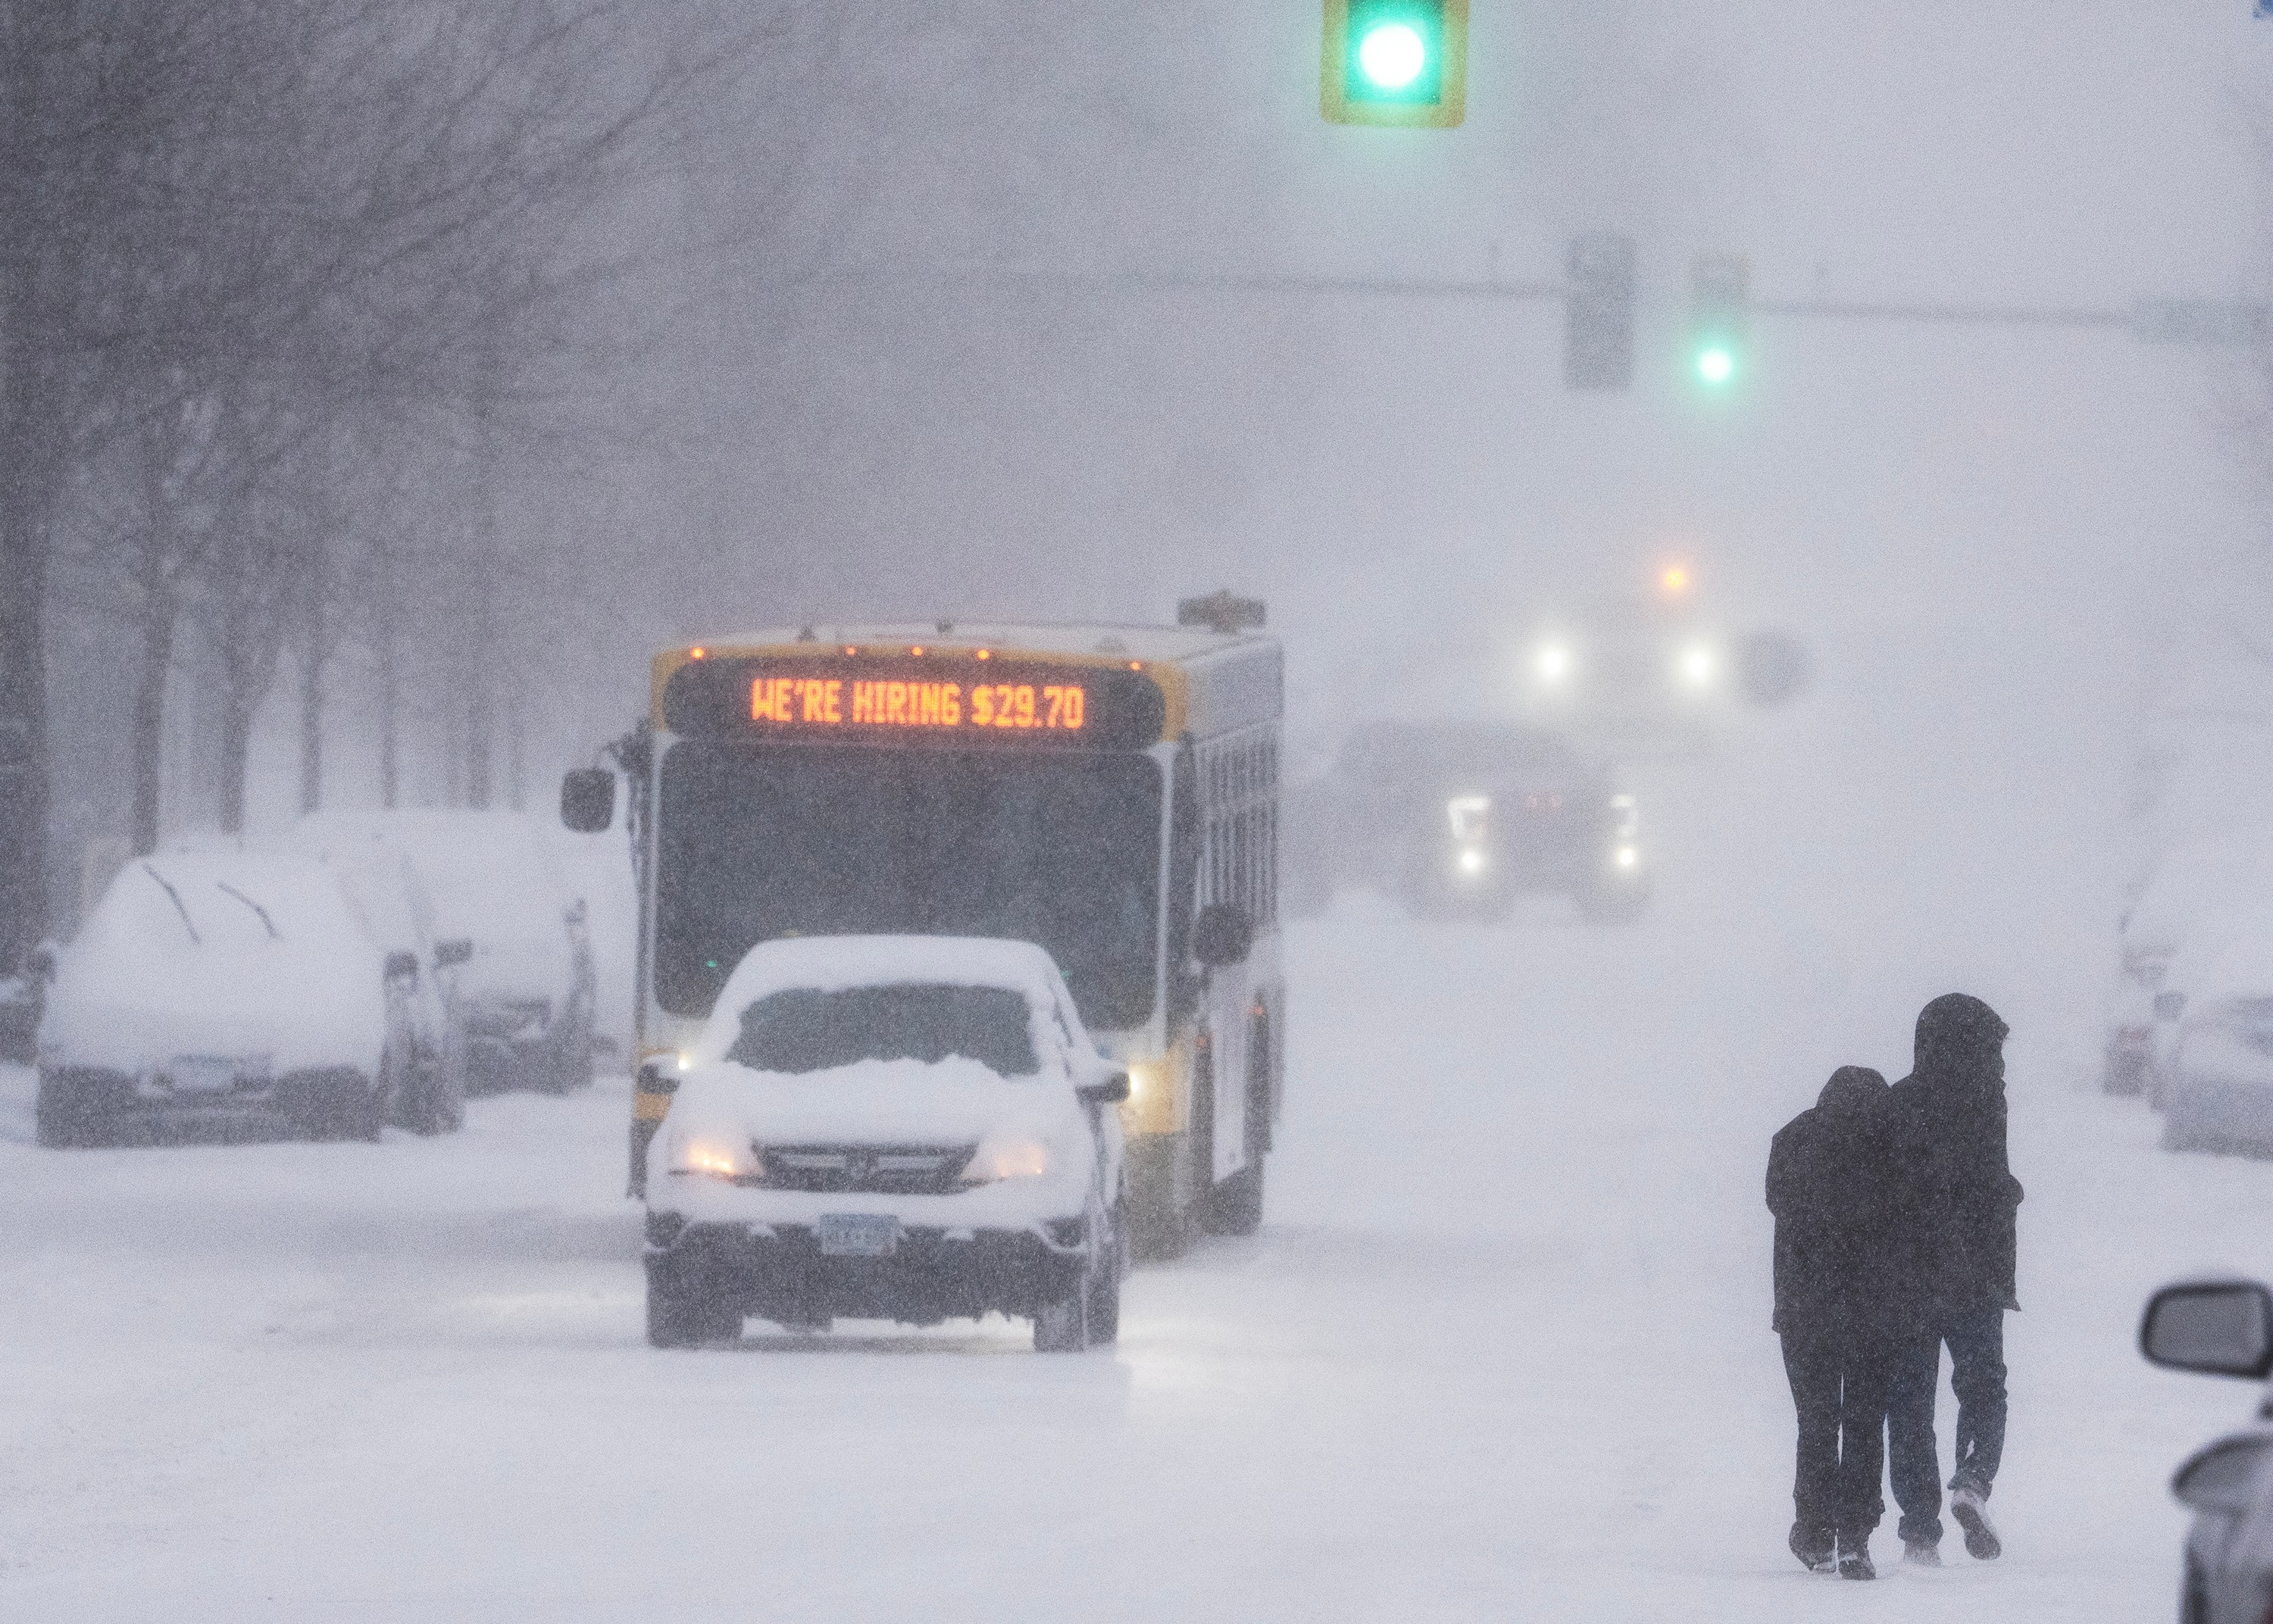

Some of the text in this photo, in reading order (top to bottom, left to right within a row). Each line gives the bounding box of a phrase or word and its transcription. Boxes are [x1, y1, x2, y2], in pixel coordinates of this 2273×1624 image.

[752, 679, 1083, 728] WE'RE HIRING $29.70
